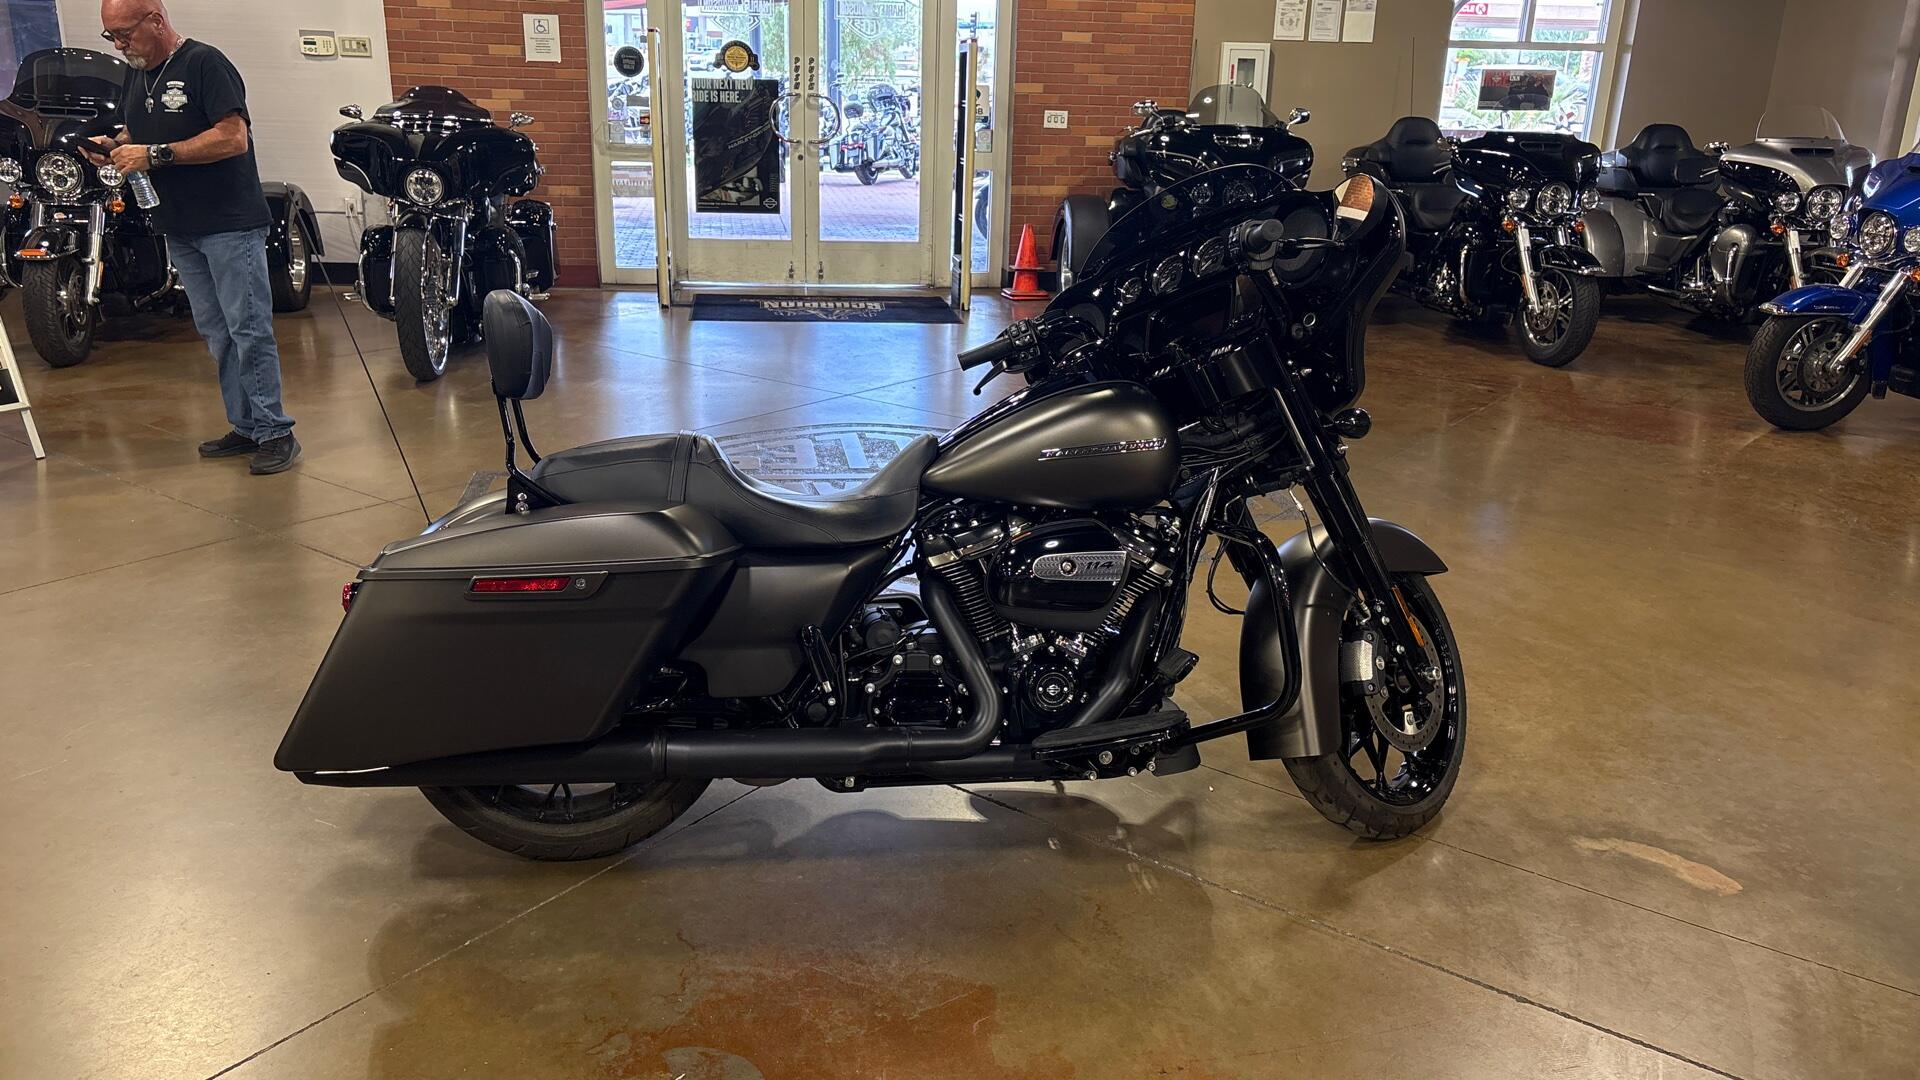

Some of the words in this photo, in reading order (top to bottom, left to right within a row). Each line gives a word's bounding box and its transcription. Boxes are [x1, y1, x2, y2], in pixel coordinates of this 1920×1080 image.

[713, 78, 733, 90] NEXT
[734, 79, 754, 91] NEW
[692, 90, 709, 102] RIDE
[710, 90, 719, 103] IS
[719, 91, 742, 103] HERE.
[1086, 561, 1114, 570] 114
